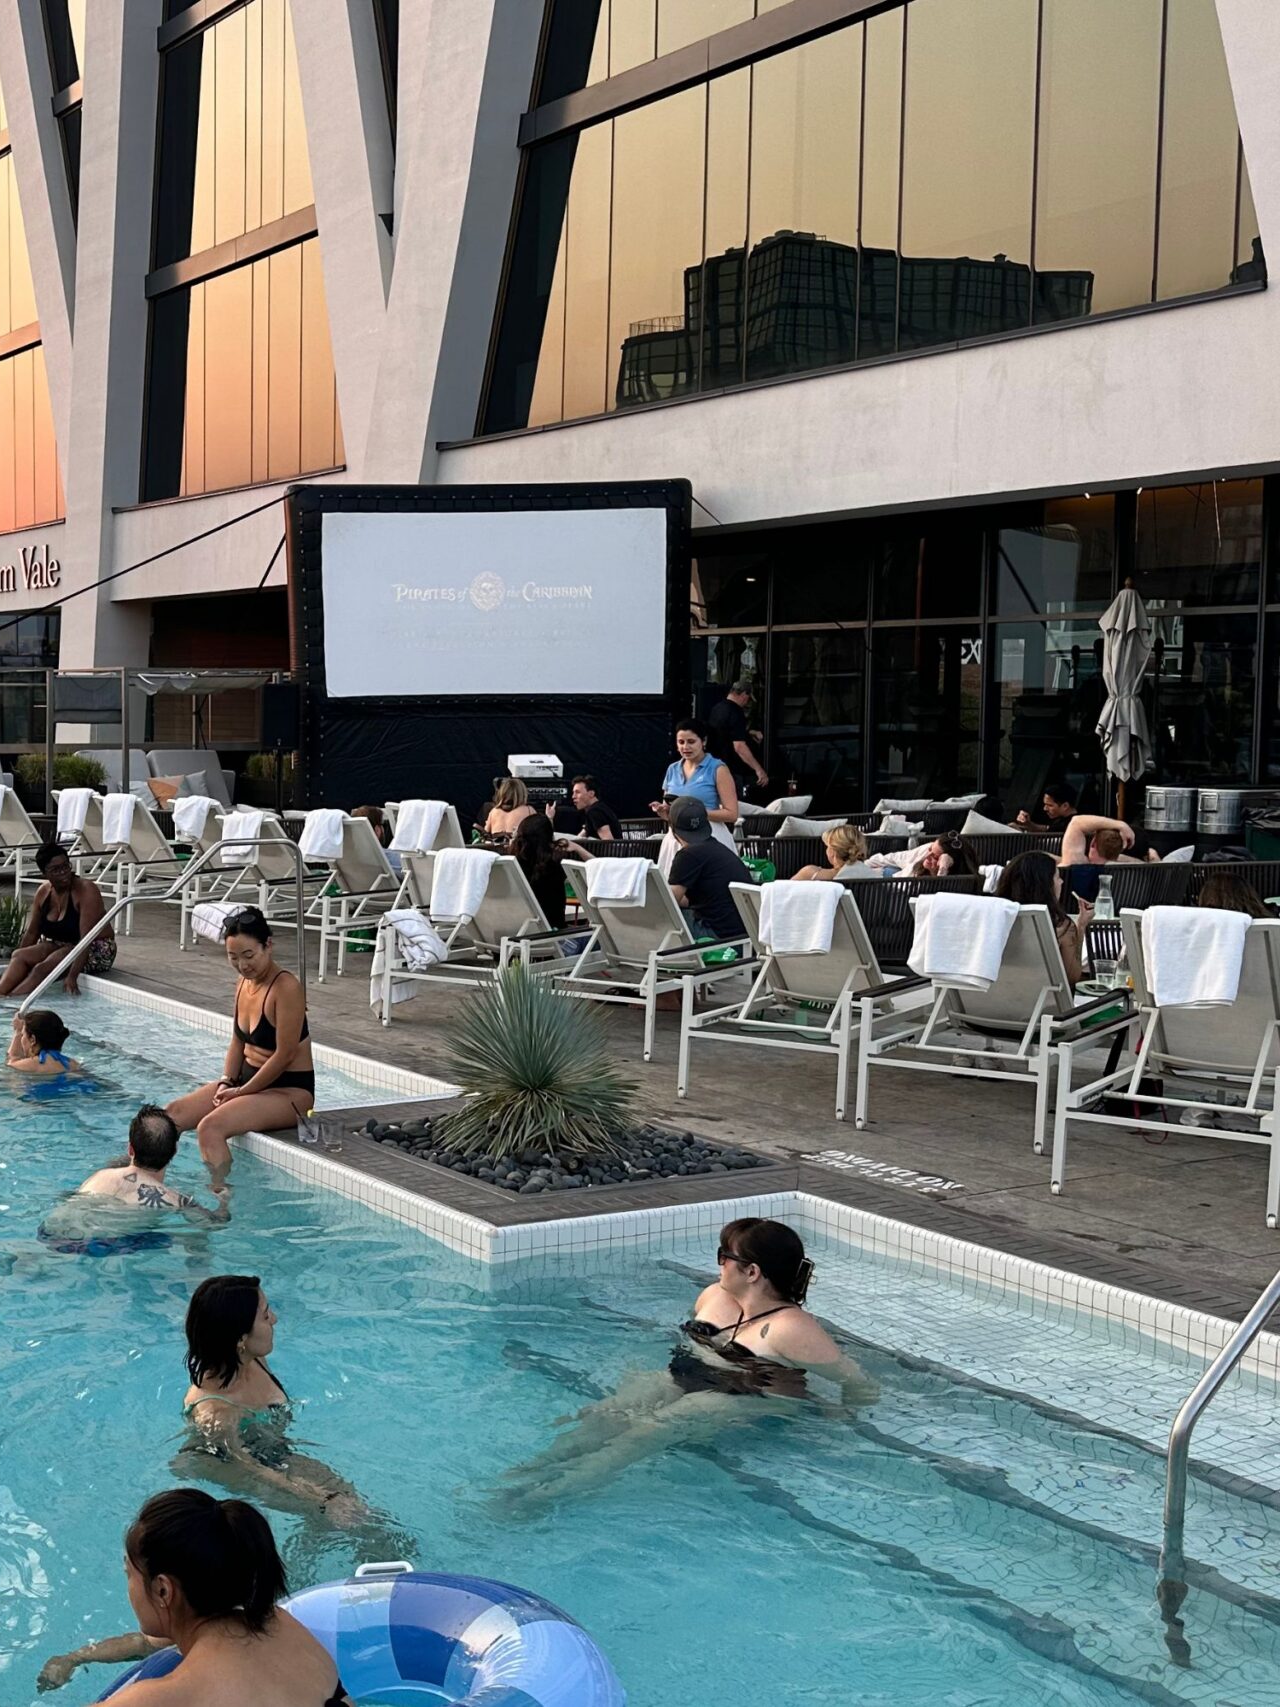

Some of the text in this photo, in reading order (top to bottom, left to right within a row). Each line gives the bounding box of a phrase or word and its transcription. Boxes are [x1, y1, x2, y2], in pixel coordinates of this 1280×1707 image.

[18, 544, 61, 590] Vale
[819, 1150, 965, 1190] NO DIVING
